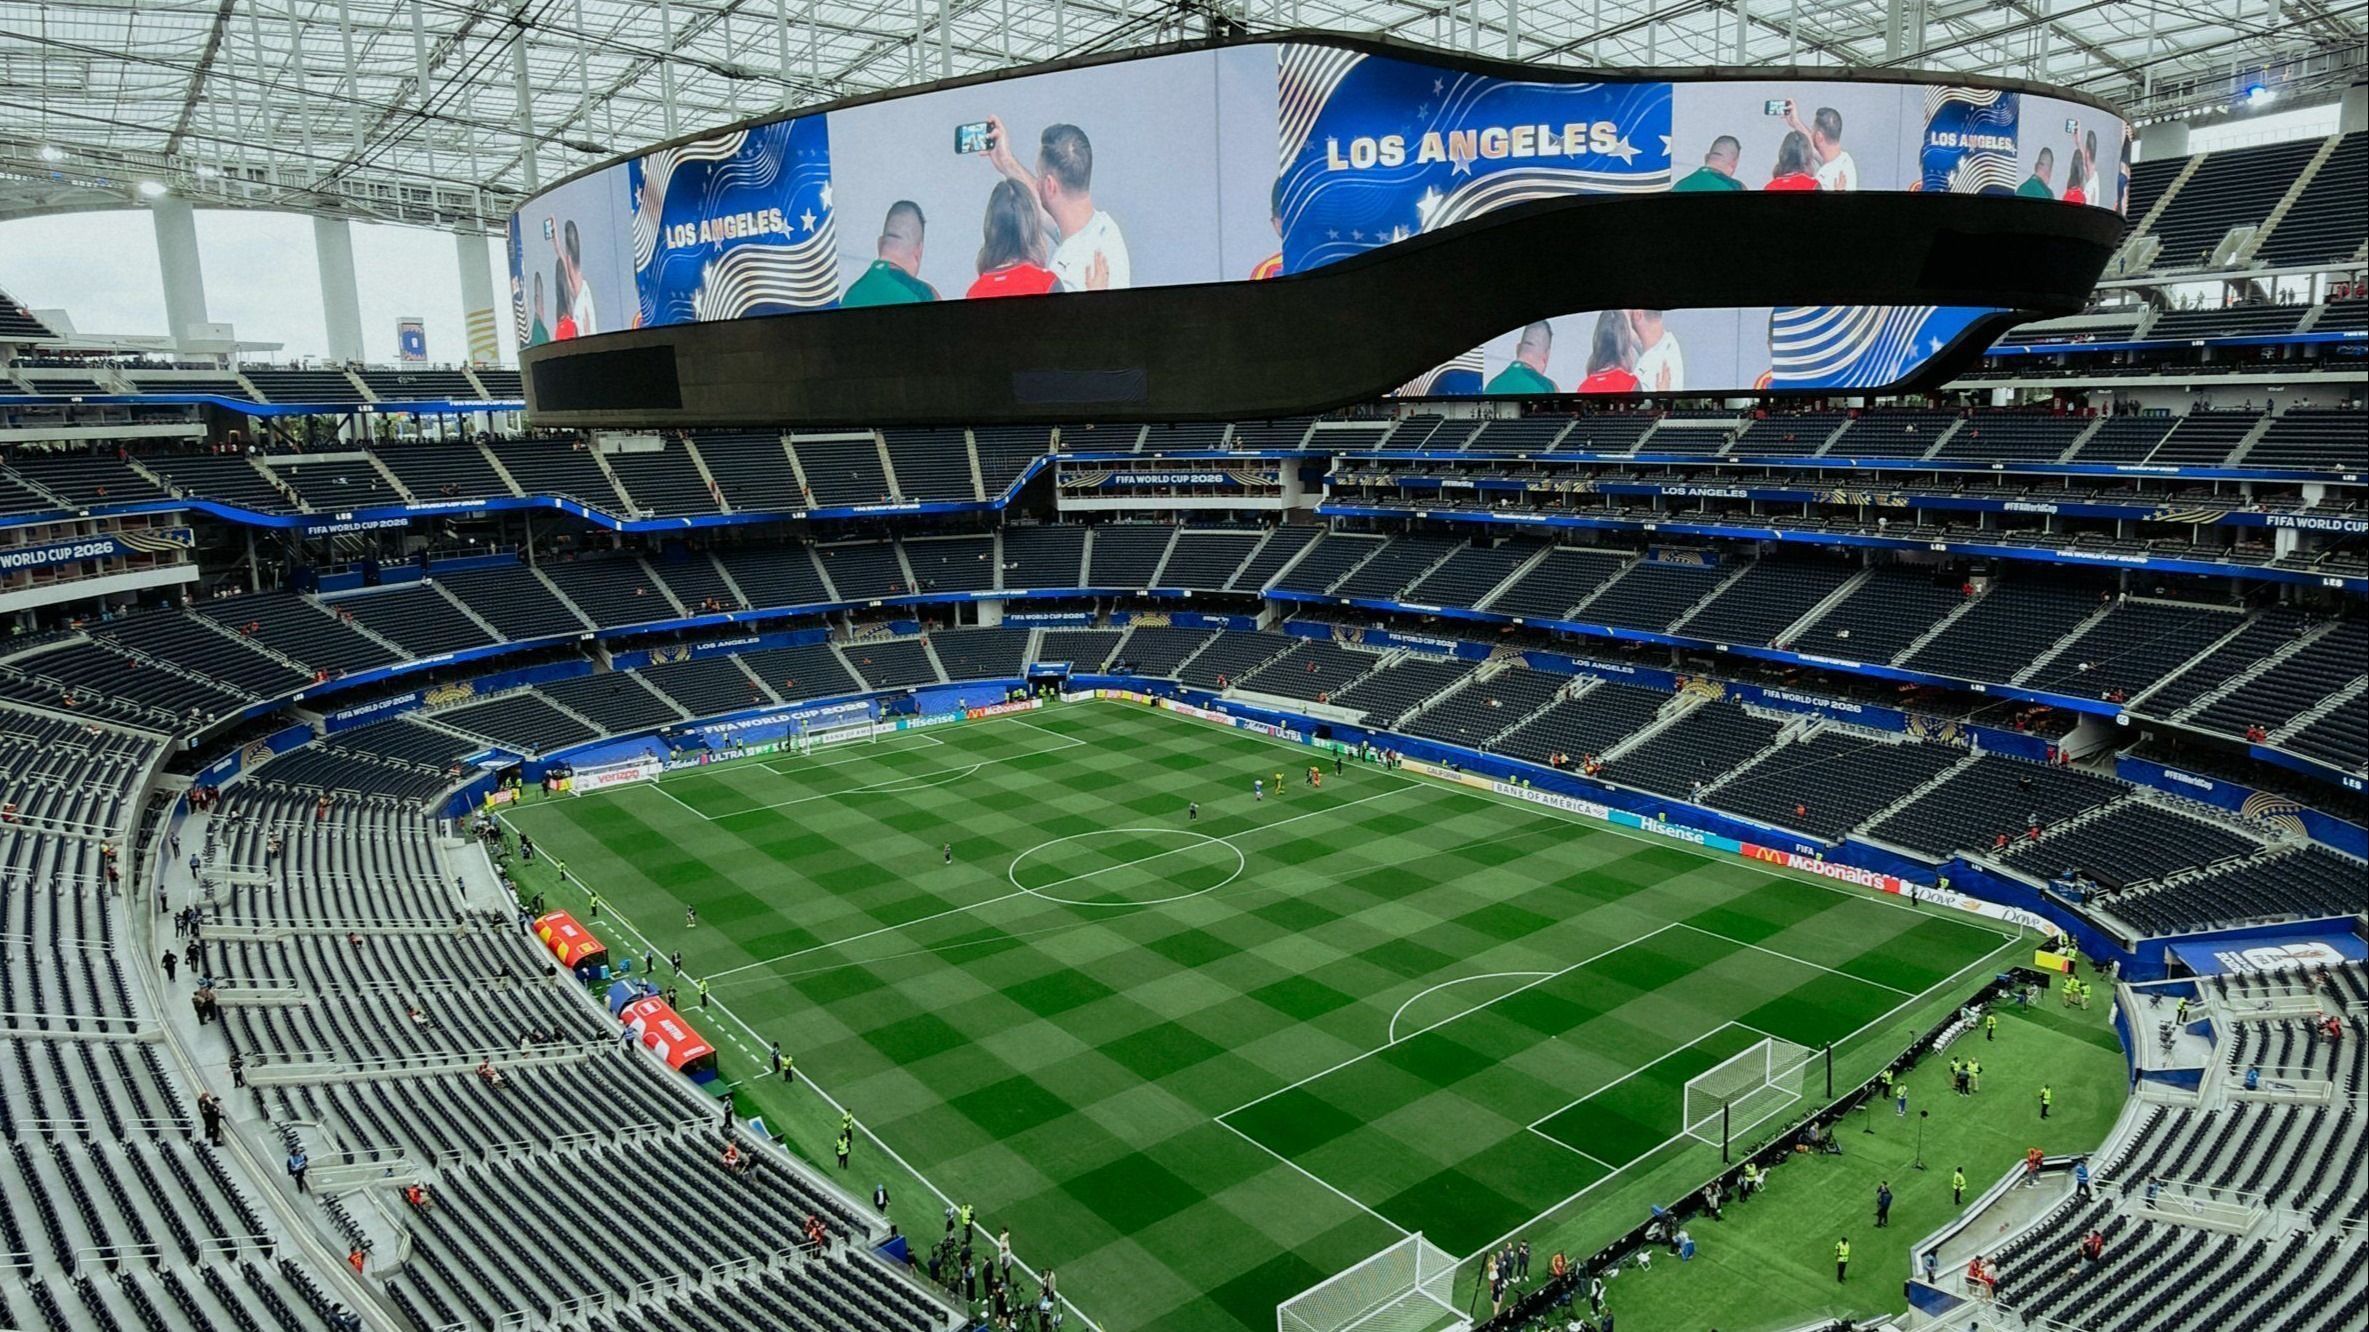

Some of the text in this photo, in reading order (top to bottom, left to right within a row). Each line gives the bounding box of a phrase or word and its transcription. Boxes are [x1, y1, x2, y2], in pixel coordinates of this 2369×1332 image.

[1327, 121, 1618, 171] LOS ANGELES
[1931, 131, 2013, 150] LOS ANGELES
[666, 207, 782, 249] LOS ANGELES
[1115, 475, 1224, 484] FIFA WORLD CUP 2026
[1661, 487, 1748, 498] LOS ANGELES
[308, 518, 409, 535] FIFA WORLD CUP 2026
[2266, 515, 2369, 532] FIFA WORLD CUP
[0, 541, 114, 569] WORLD CUP 2026
[2323, 577, 2344, 588] LES
[717, 637, 760, 647] ANGELES
[1572, 659, 1635, 674] LOS ANGELES
[337, 693, 416, 720] FIFA WORLD CUP 2026
[1763, 689, 1863, 713] FIFA WORLD CUP 2026
[704, 722, 739, 734] FIFA
[737, 714, 790, 727] WORLD
[791, 708, 819, 720] CUP
[820, 700, 869, 717] 2026
[907, 713, 956, 729] Hisense
[1275, 727, 1303, 743] ULTRA
[709, 749, 745, 762] ULTRA
[1427, 766, 1462, 781] CALIFORNIA
[2343, 776, 2362, 790] LES
[1497, 783, 1592, 814] BANK OF AMERICA
[1640, 816, 1705, 845] Hisense
[1795, 843, 1815, 855] FIFA
[1787, 854, 1885, 890] McDonald's
[1919, 889, 1956, 906] Dove
[2001, 907, 2041, 926] Dove
